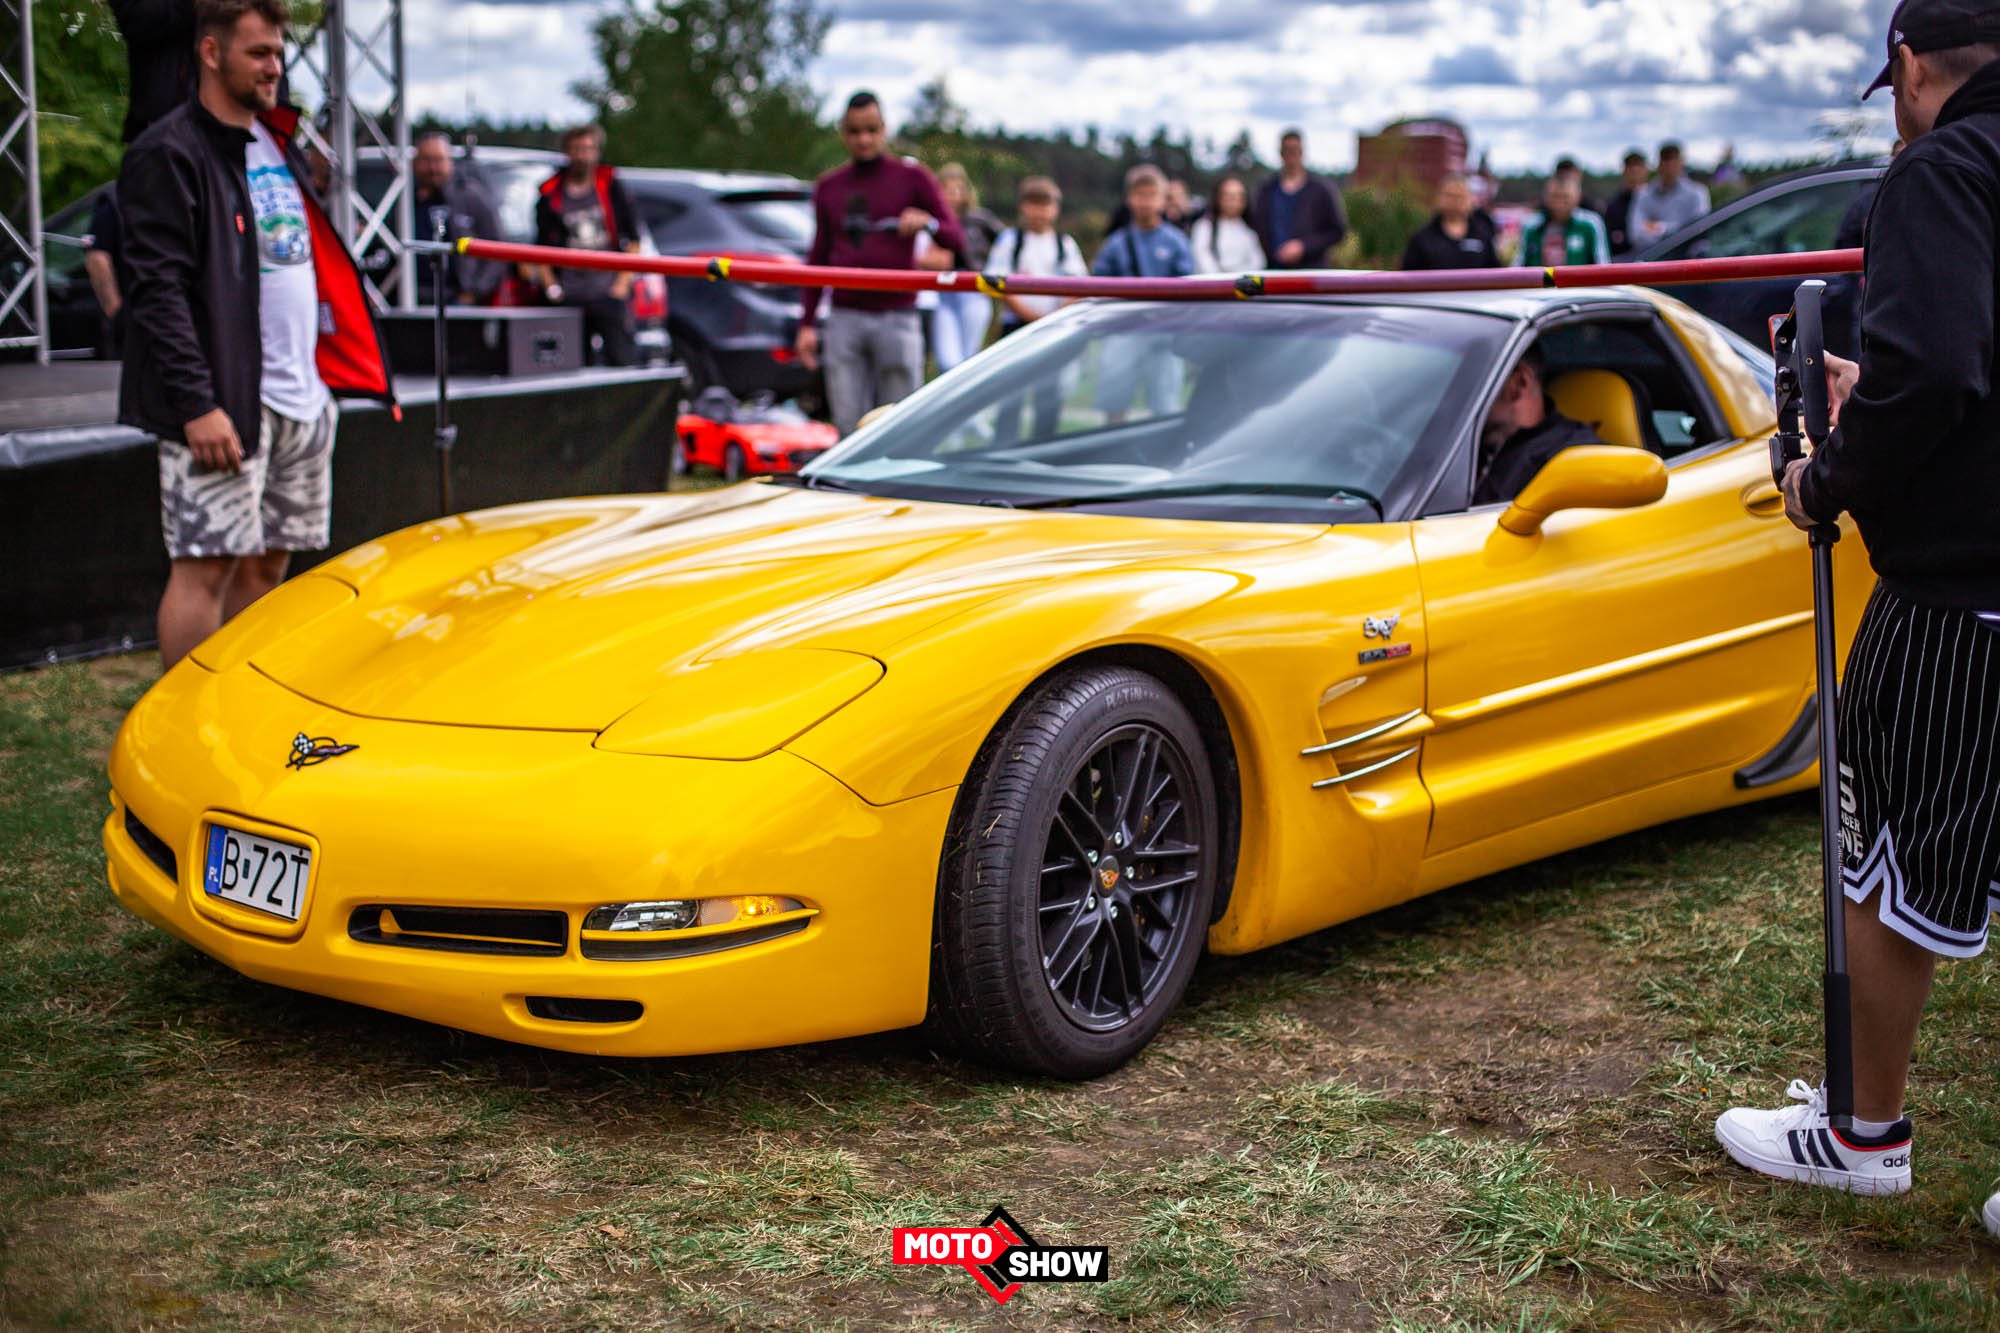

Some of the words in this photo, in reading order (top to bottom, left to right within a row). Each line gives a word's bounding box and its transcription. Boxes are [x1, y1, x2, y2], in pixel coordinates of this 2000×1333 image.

[1841, 812, 1861, 832] BER
[1841, 826, 1863, 860] NE
[208, 866, 219, 882] PL
